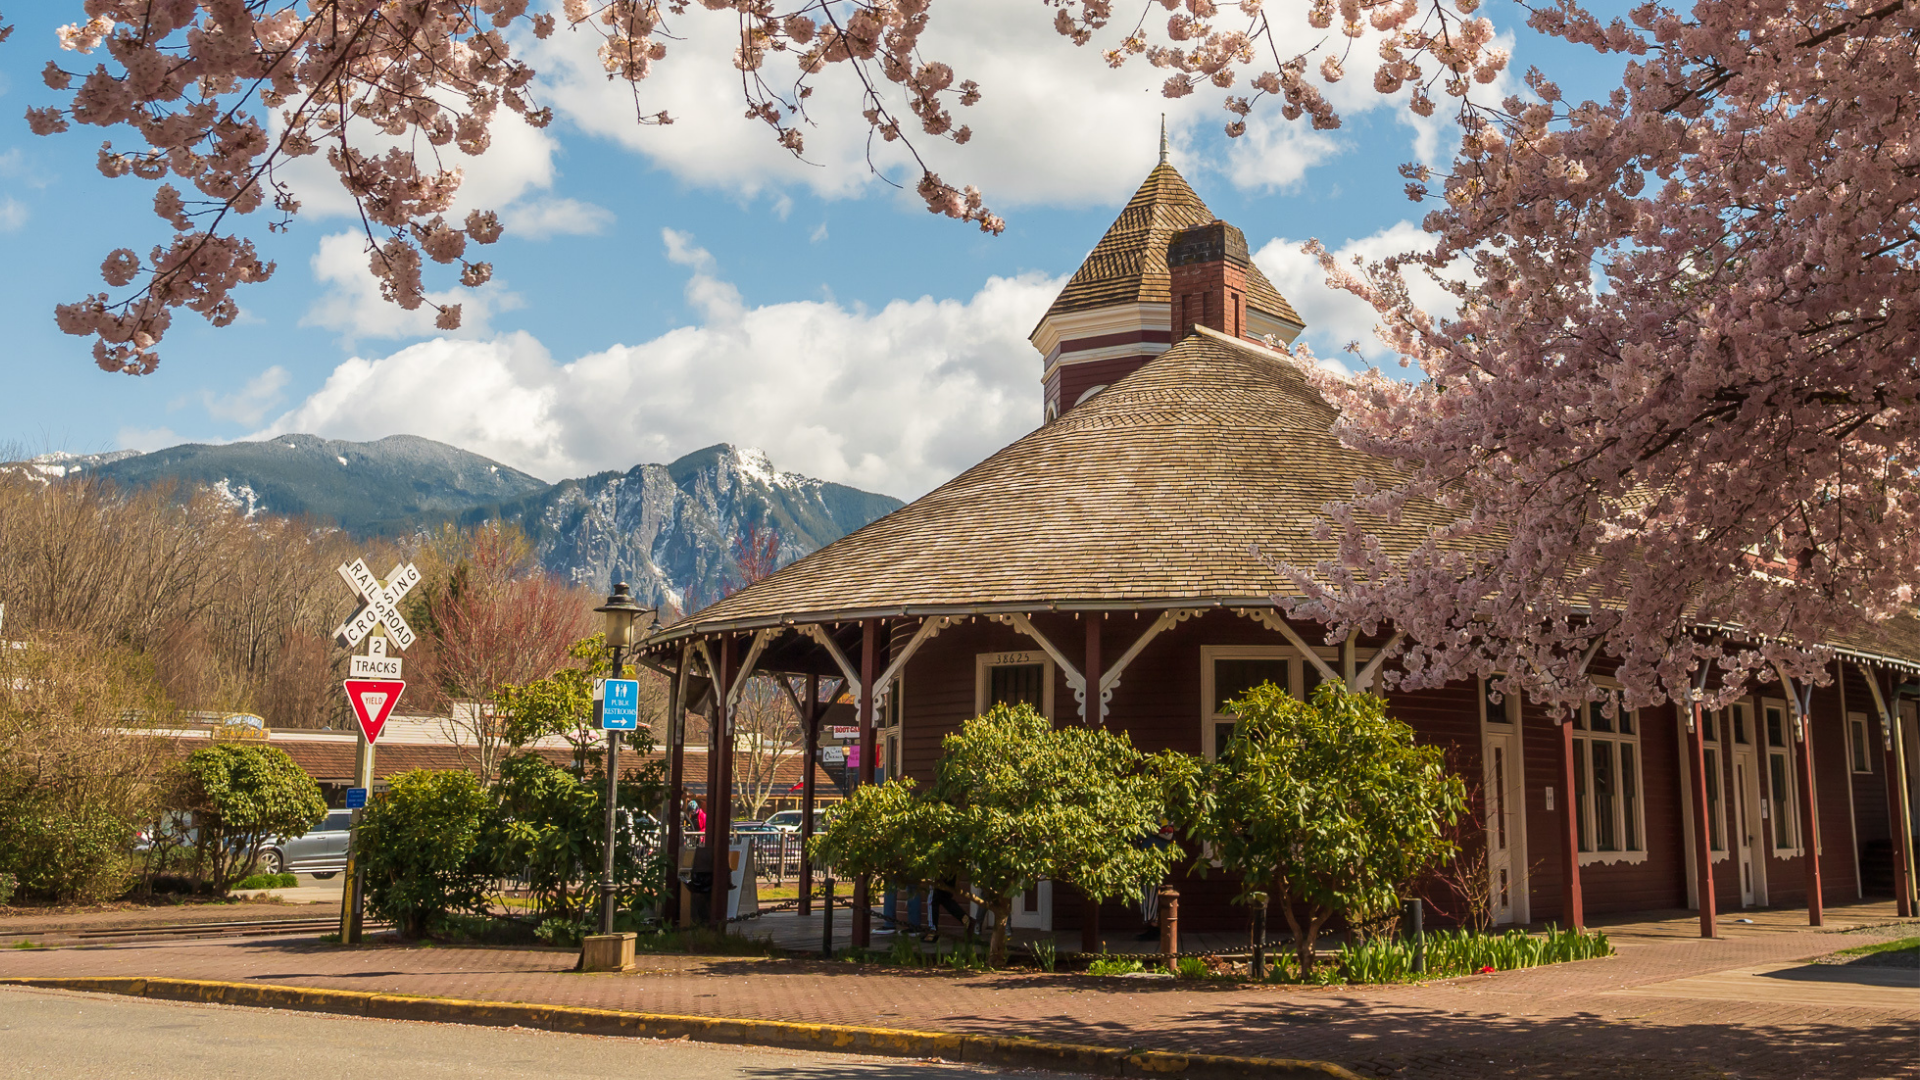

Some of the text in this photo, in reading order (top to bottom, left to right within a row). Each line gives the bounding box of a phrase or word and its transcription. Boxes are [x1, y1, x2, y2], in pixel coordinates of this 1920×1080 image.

[348, 568, 417, 641] CROSSING
[373, 640, 381, 654] 2
[996, 653, 1030, 664] 38625
[355, 660, 397, 674] TRACKS
[364, 696, 383, 705] YIELD
